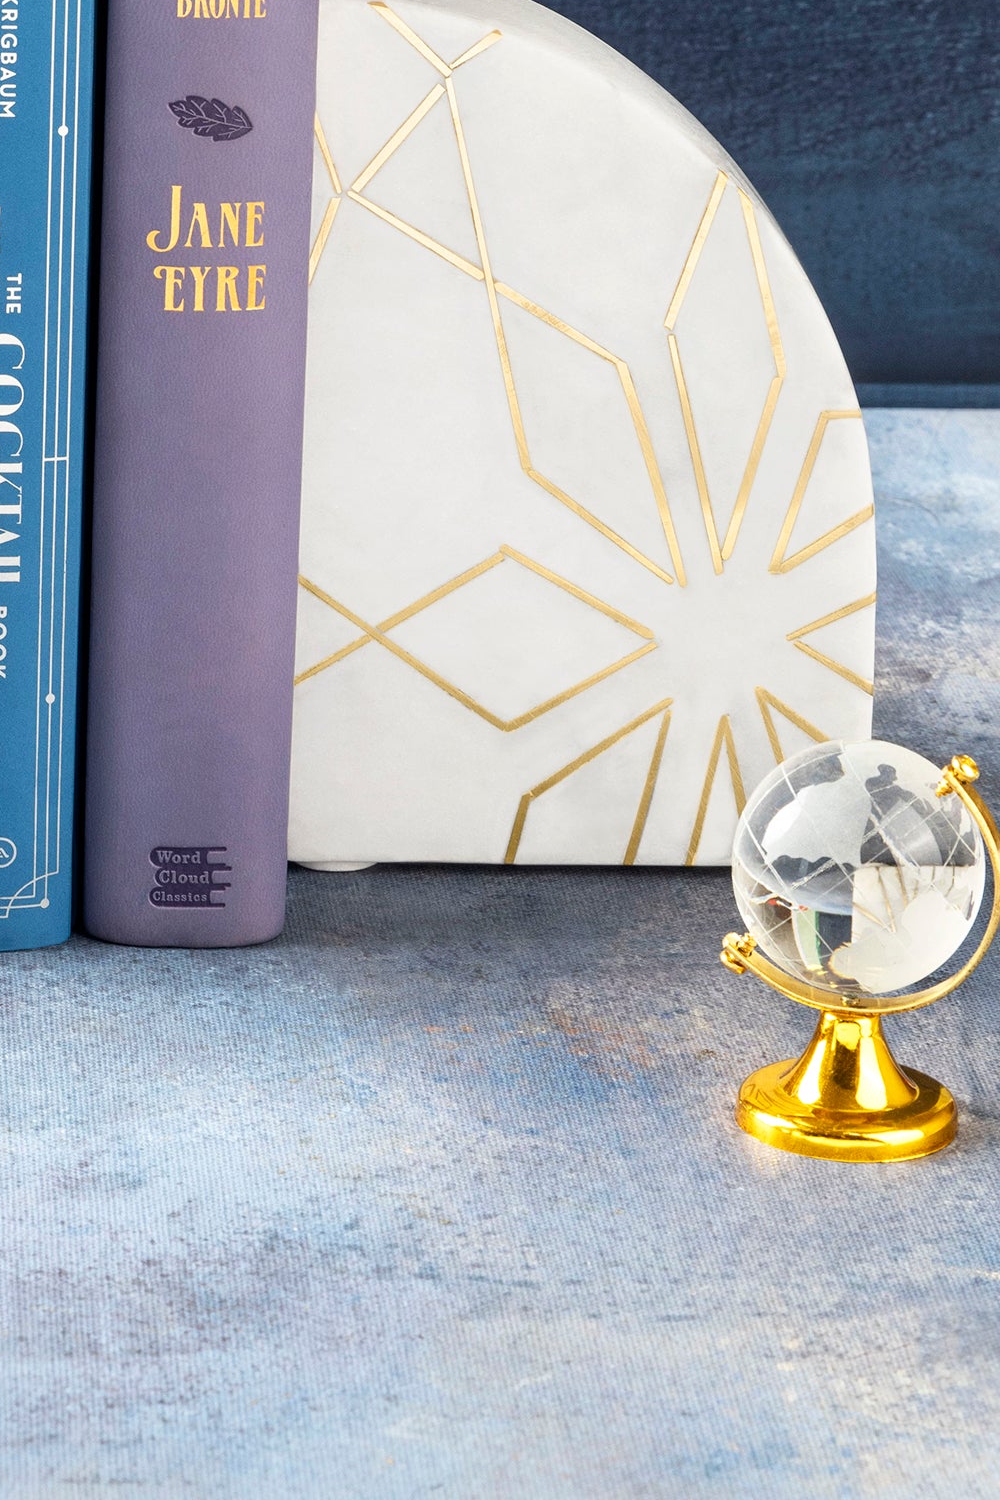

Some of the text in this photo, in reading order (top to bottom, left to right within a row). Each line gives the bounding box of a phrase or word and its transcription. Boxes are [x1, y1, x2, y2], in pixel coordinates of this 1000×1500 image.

[146, 185, 265, 253] JANE
[6, 272, 22, 314] THE
[153, 264, 267, 312] EYRE
[156, 850, 201, 864] Word
[159, 870, 210, 884] Cloud
[152, 891, 208, 902] Classics
